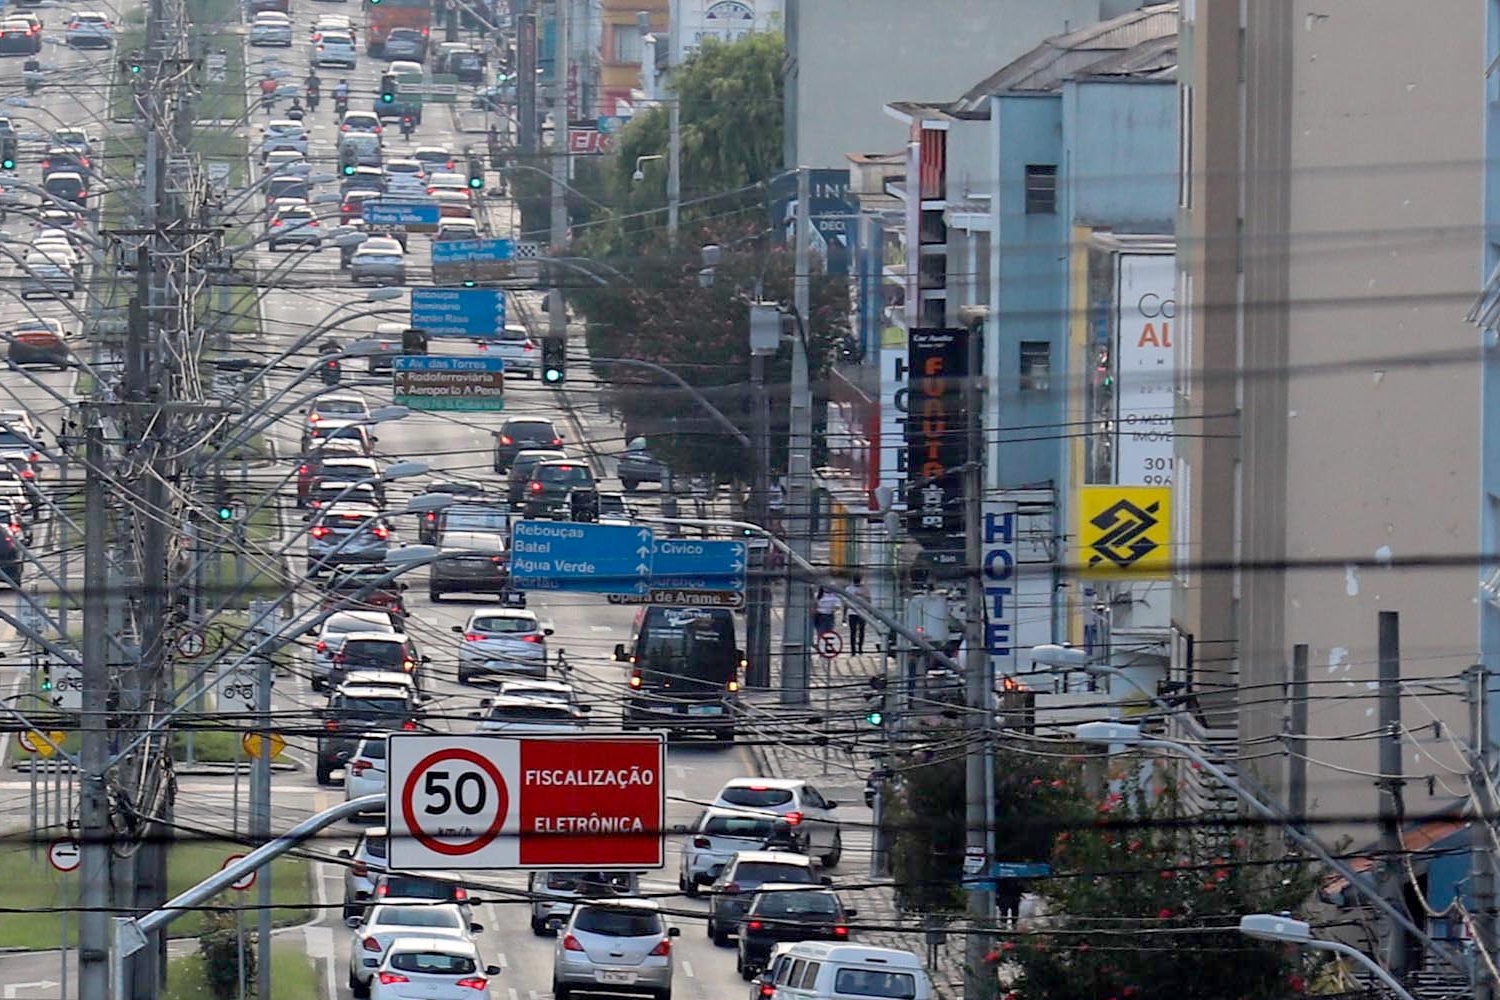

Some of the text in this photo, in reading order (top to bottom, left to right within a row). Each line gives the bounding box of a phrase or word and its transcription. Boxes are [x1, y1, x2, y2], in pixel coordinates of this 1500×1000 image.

[408, 359, 487, 369] Av. das Torres
[408, 372, 494, 382] Rodoferroviária
[408, 385, 462, 396] Aeroporto
[515, 523, 584, 539] Rebouças
[515, 541, 550, 553] Batel
[514, 556, 596, 573] Água Verde
[656, 591, 673, 603] de
[677, 591, 722, 605] Arame
[525, 765, 654, 789] FISCALIZAÇÃO
[424, 770, 487, 815] 50
[534, 812, 643, 833] ELETRÔNICA
